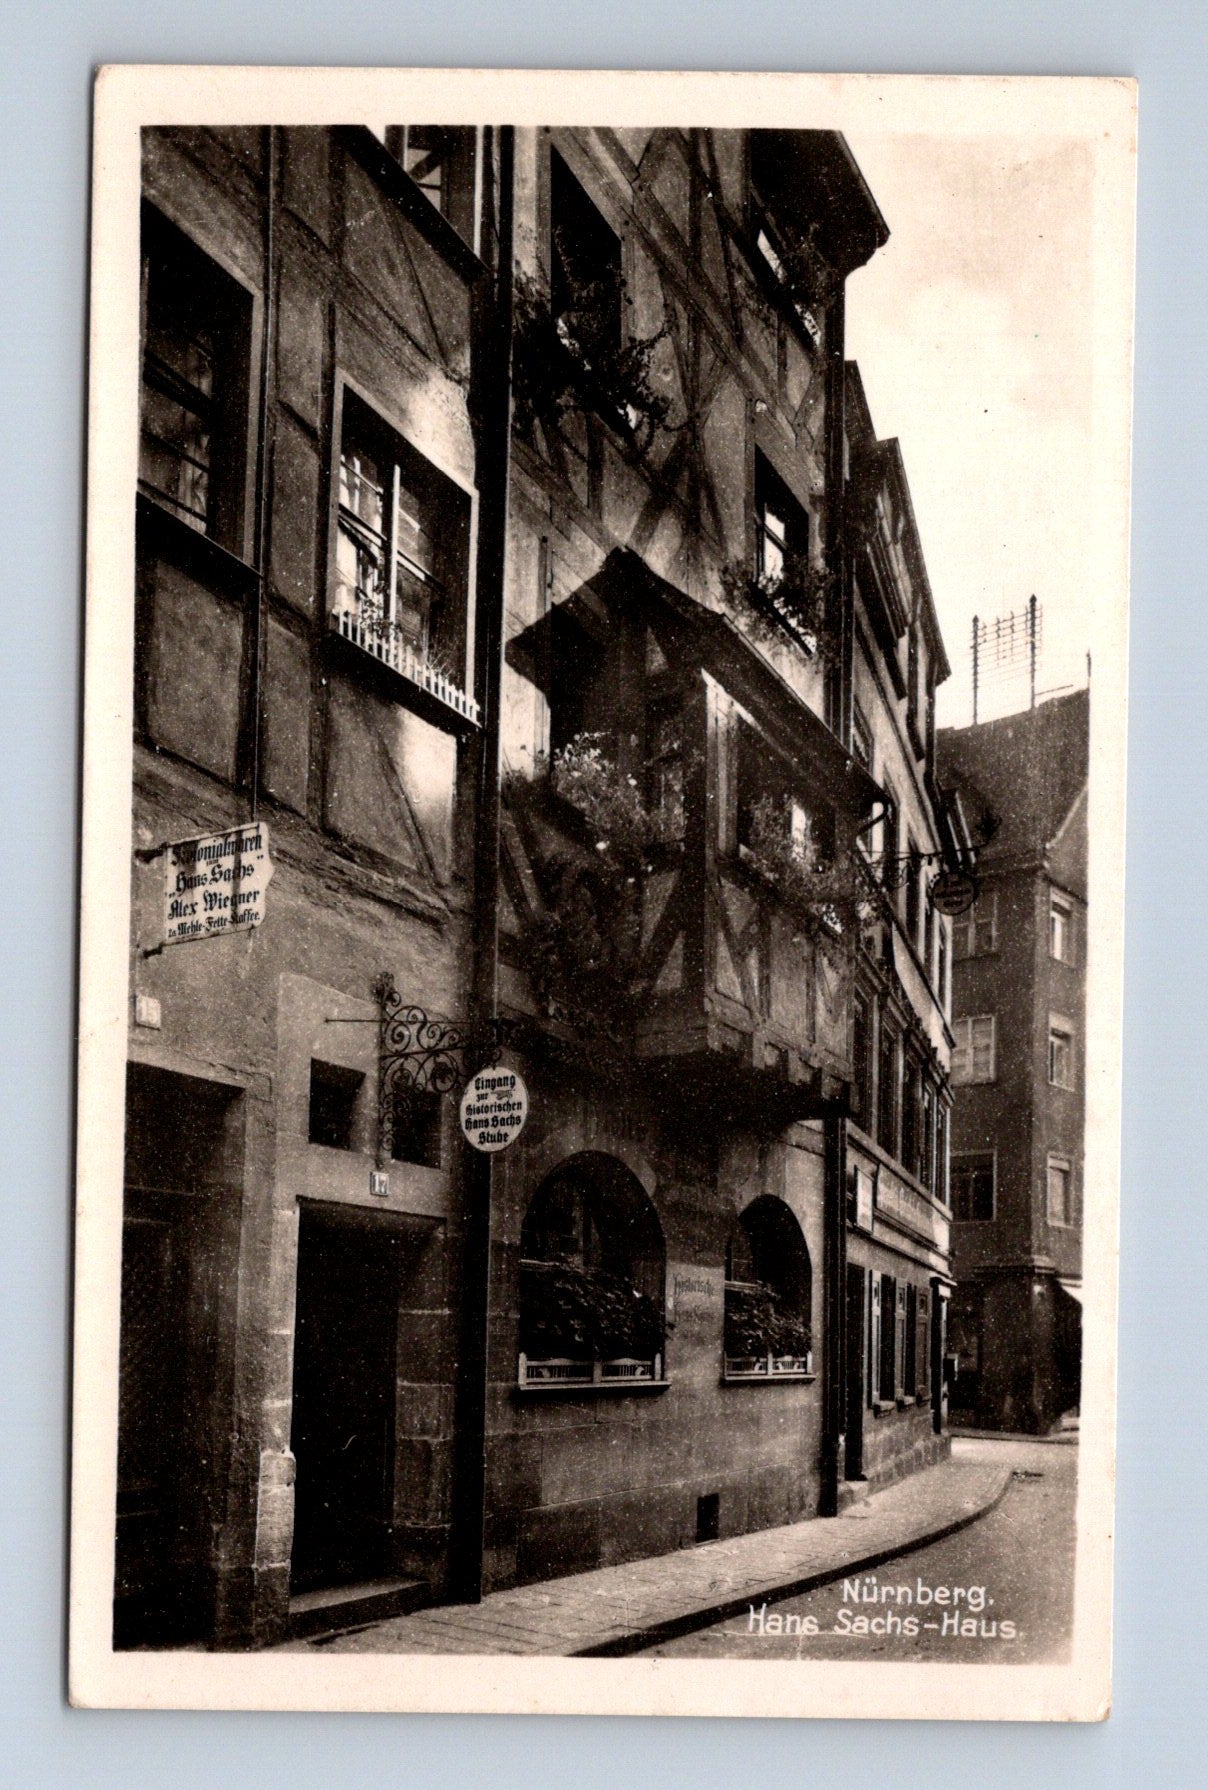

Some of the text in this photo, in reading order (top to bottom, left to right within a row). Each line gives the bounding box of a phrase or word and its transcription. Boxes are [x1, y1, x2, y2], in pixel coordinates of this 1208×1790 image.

[168, 900, 199, 920] Alex
[474, 1074, 516, 1091] Eingang
[476, 1092, 489, 1102] zur
[465, 1100, 522, 1116] Historischen
[464, 1113, 522, 1132] Hans Sachs
[478, 1129, 509, 1145] Stube
[374, 1174, 388, 1194] 17
